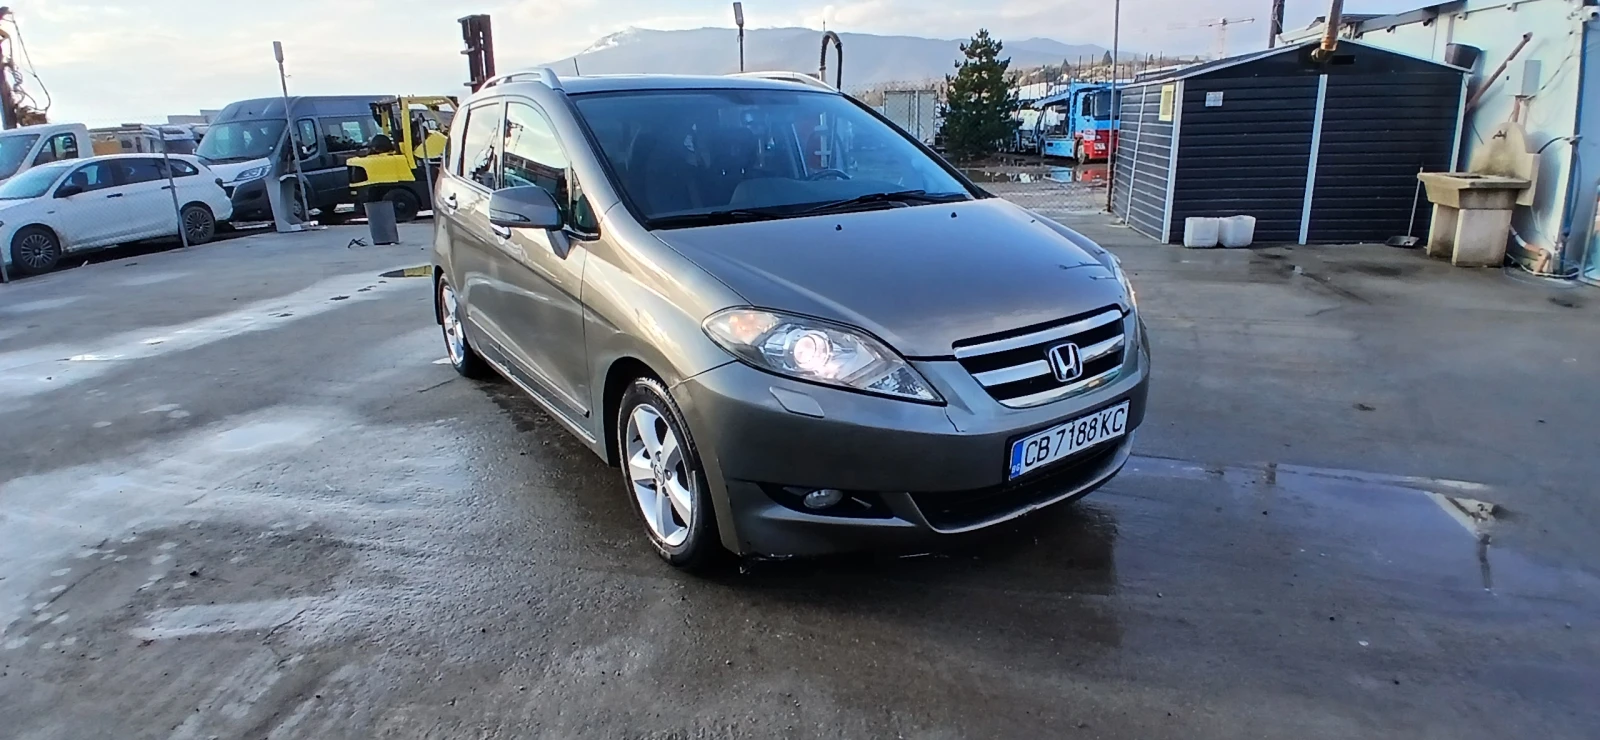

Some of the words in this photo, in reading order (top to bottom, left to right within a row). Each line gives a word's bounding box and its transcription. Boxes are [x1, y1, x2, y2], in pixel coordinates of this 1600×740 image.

[1024, 435, 1051, 467] CB
[1054, 418, 1098, 456] 7188
[1099, 407, 1125, 438] KC
